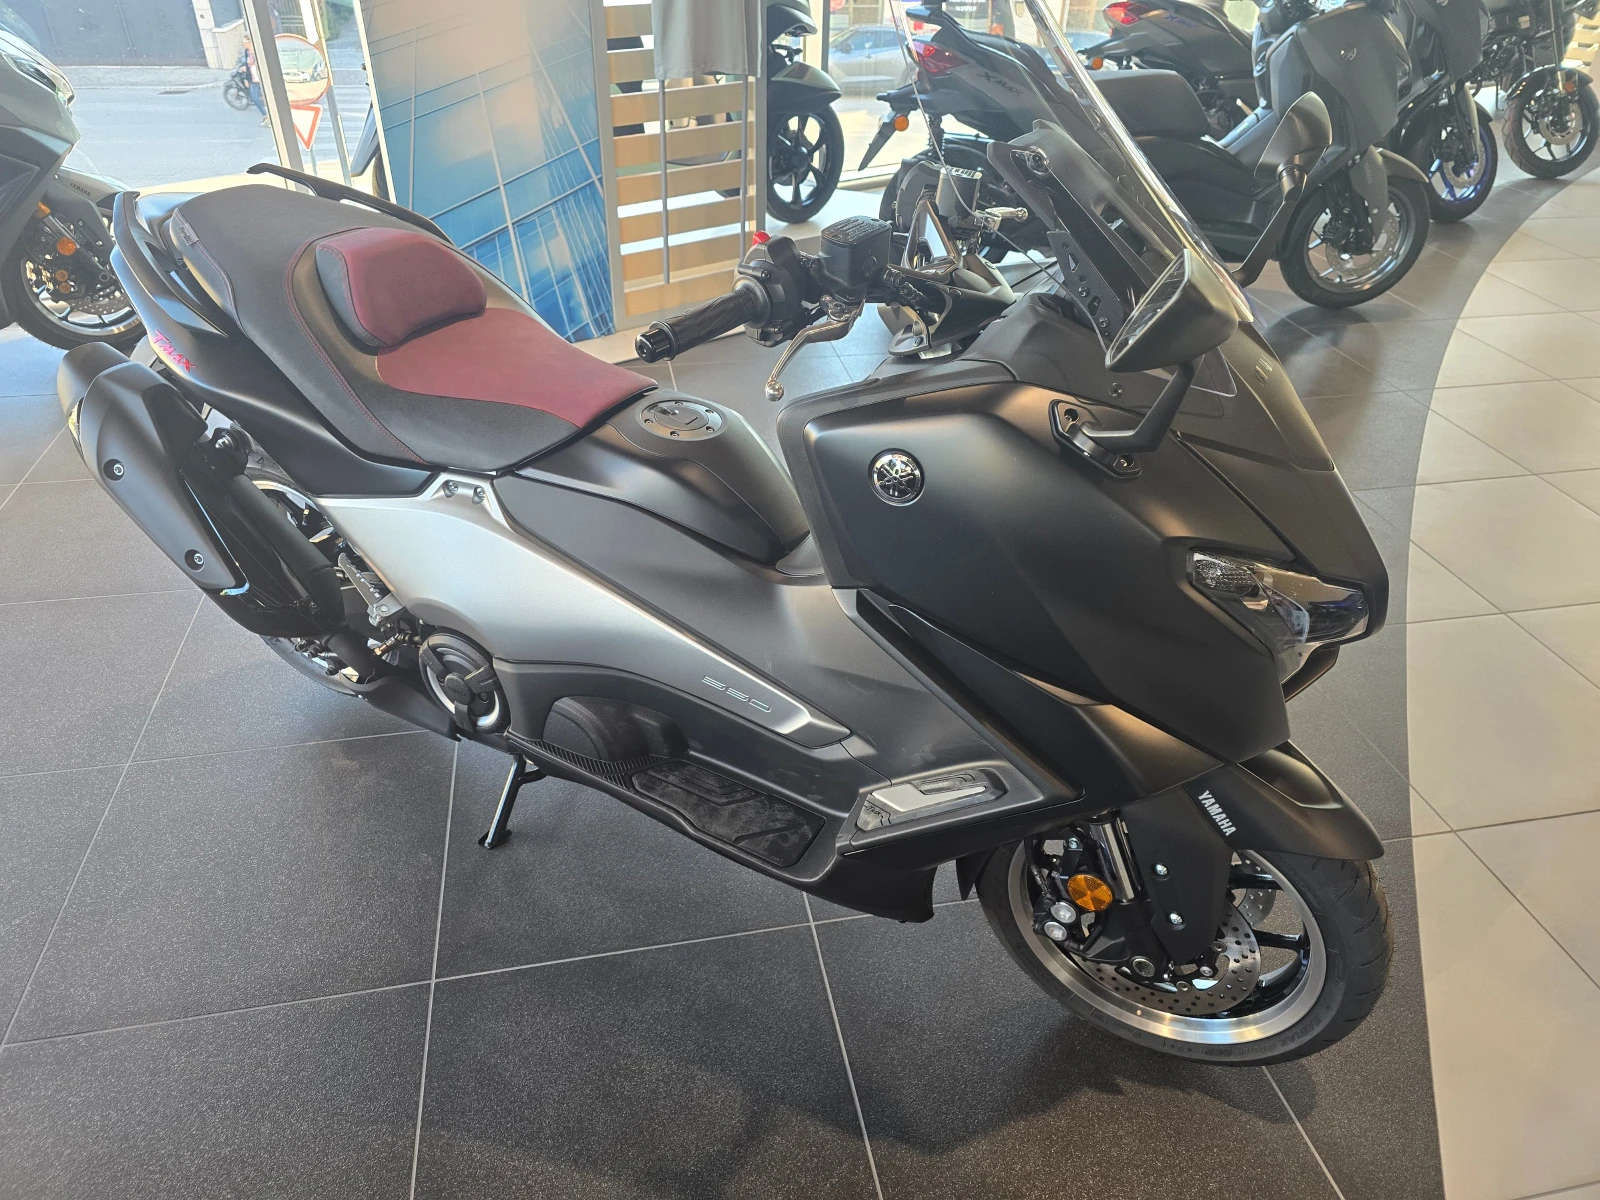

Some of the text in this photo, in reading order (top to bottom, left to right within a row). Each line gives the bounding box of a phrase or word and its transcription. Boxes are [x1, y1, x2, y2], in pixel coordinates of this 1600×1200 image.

[70, 181, 91, 197] YAMAHA
[153, 329, 198, 373] TMAX
[1198, 790, 1237, 836] YAMAHA
